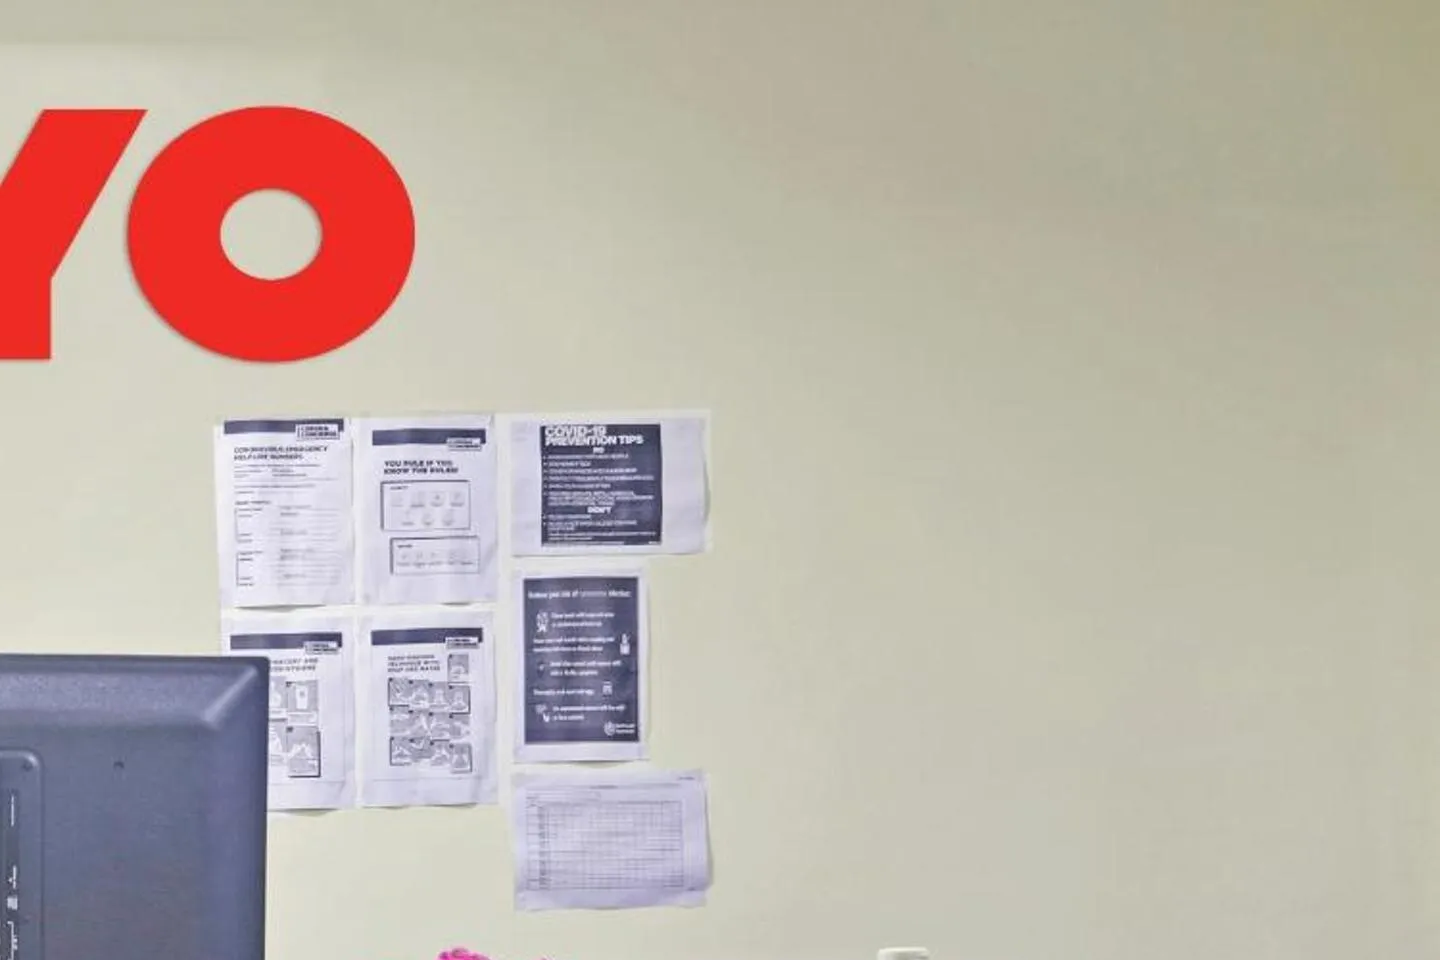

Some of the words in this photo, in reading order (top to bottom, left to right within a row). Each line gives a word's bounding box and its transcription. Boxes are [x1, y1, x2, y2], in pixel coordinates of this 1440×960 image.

[544, 425, 607, 437] COVID-19
[544, 435, 617, 447] PREVENTION
[618, 434, 644, 445] TIPS
